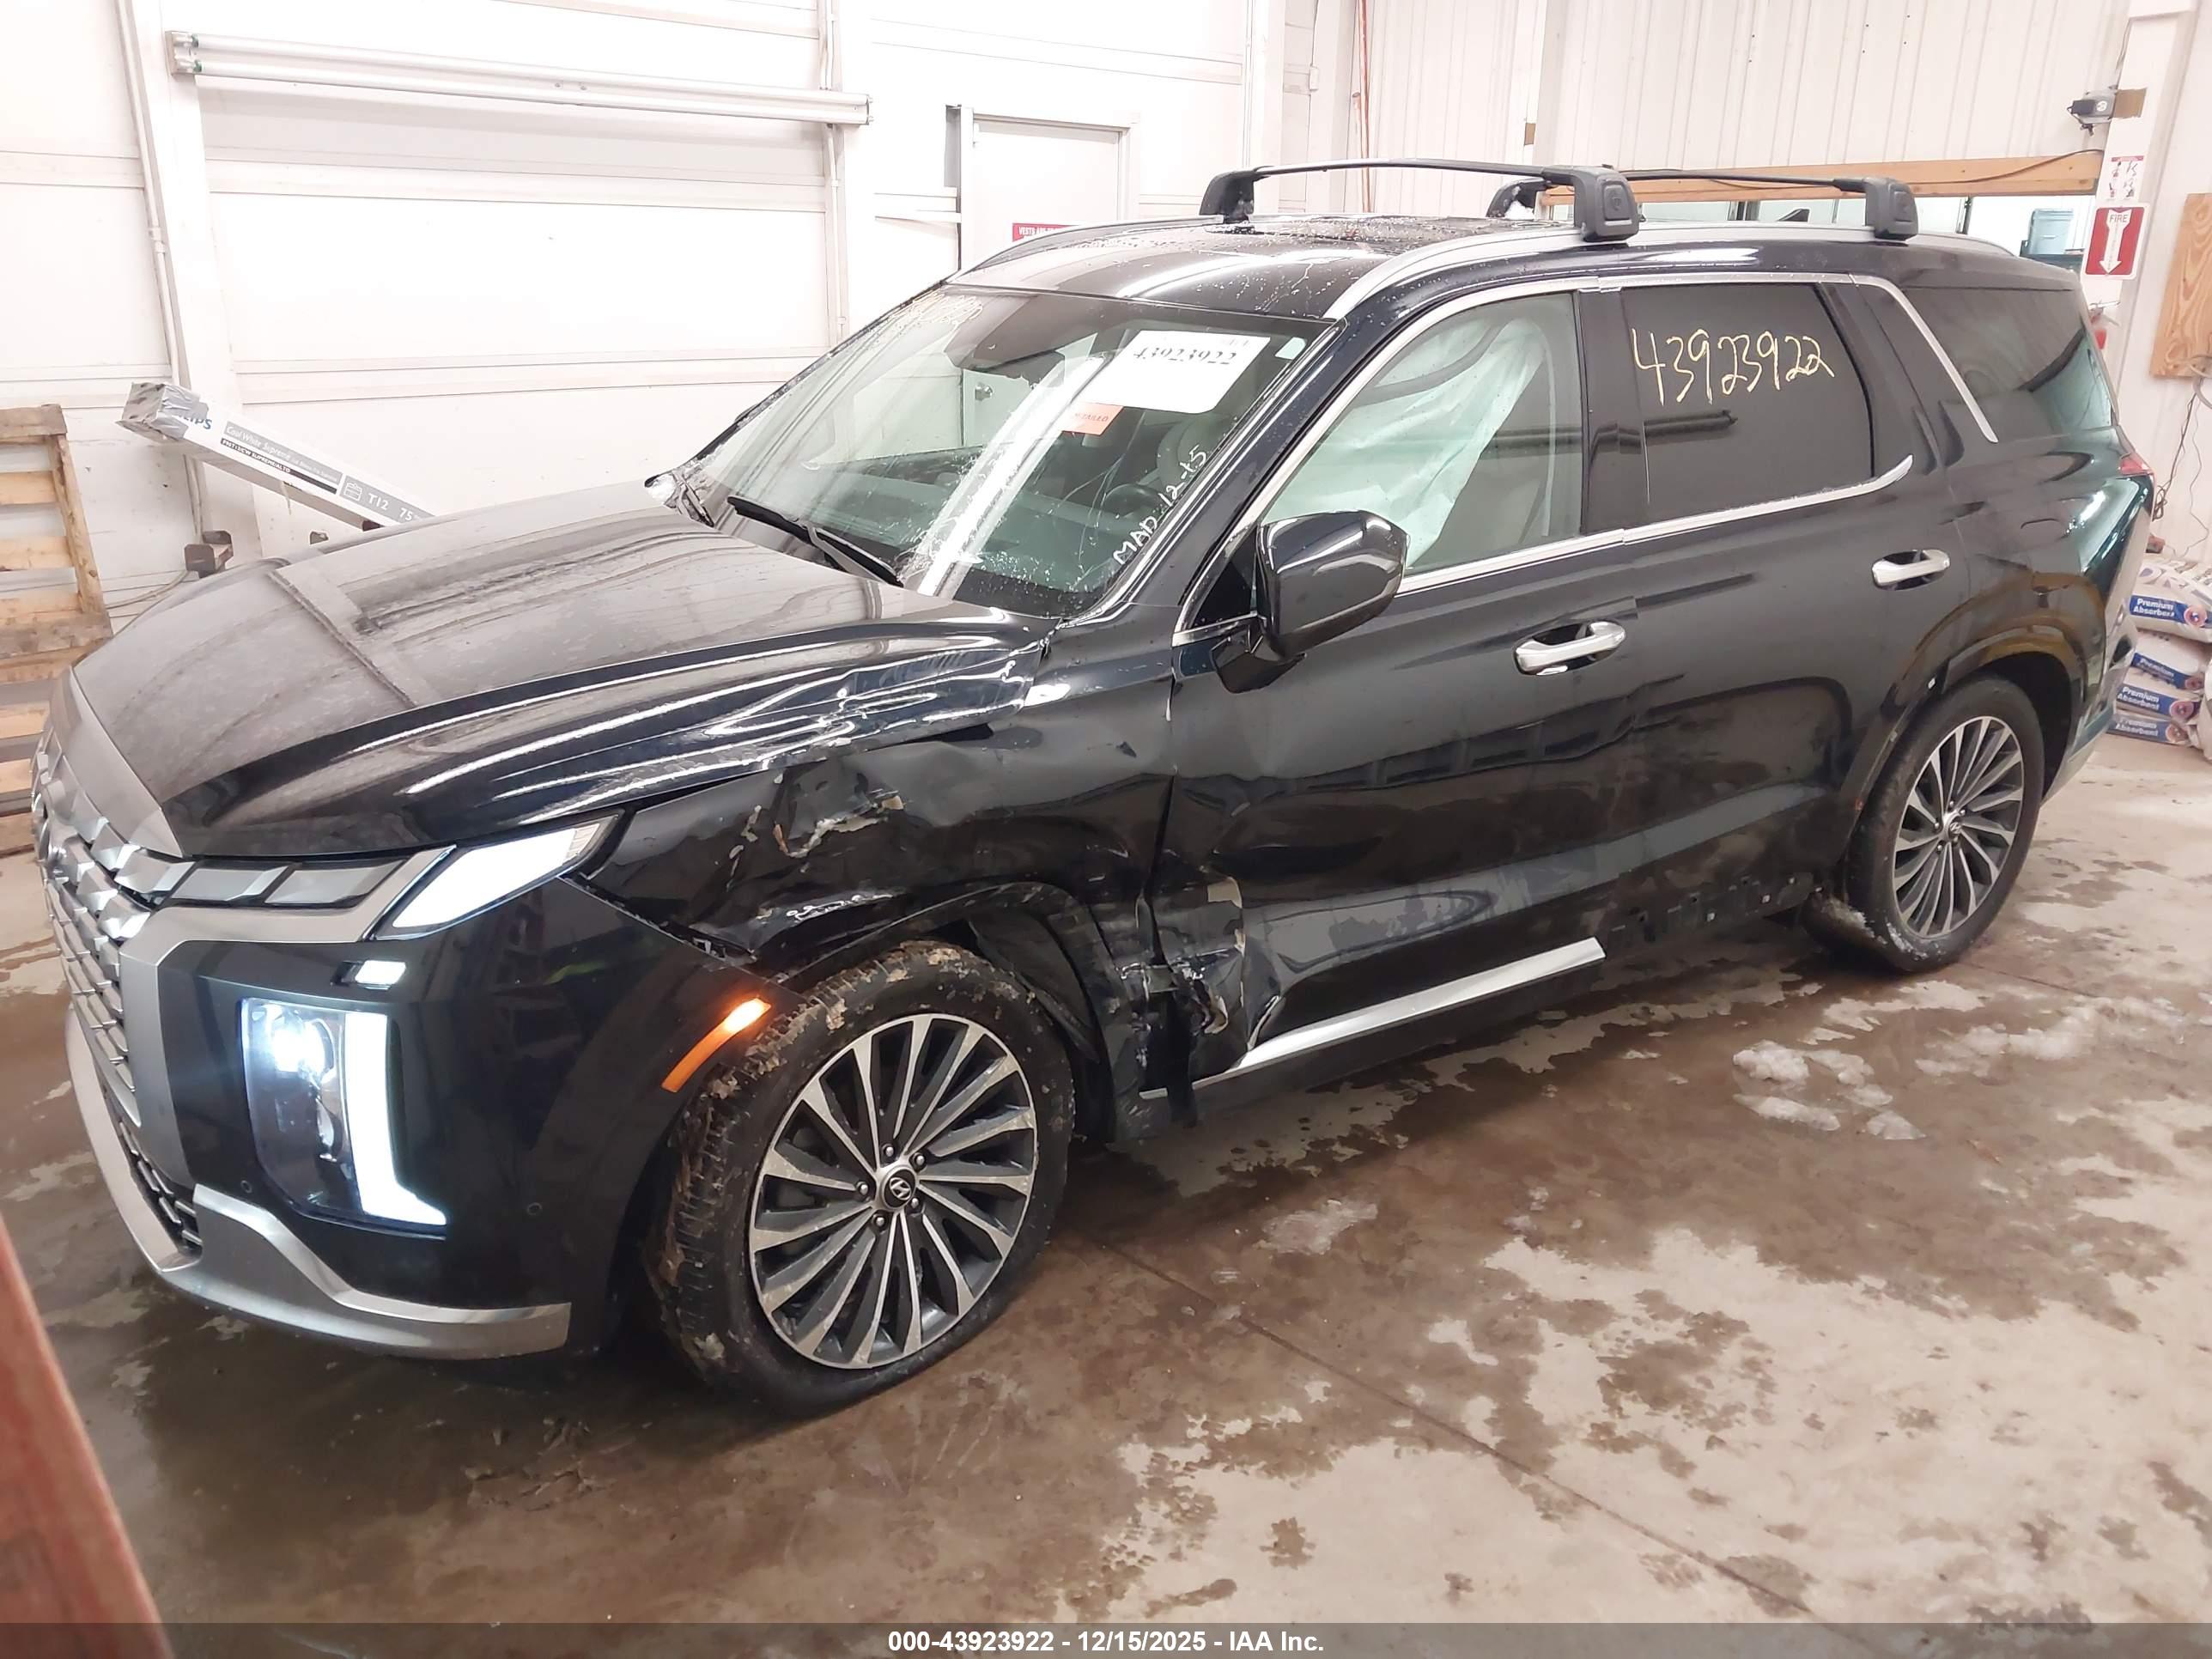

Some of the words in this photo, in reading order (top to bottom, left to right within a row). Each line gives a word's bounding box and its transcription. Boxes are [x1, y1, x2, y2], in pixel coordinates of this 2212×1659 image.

[2110, 214, 2129, 223] FIRE
[1018, 226, 1036, 235] VESTS
[1632, 328, 1835, 406] 43923922
[368, 492, 390, 510] T12
[399, 507, 413, 521] 75
[2136, 598, 2174, 611] Premium
[2123, 686, 2160, 703] Premium
